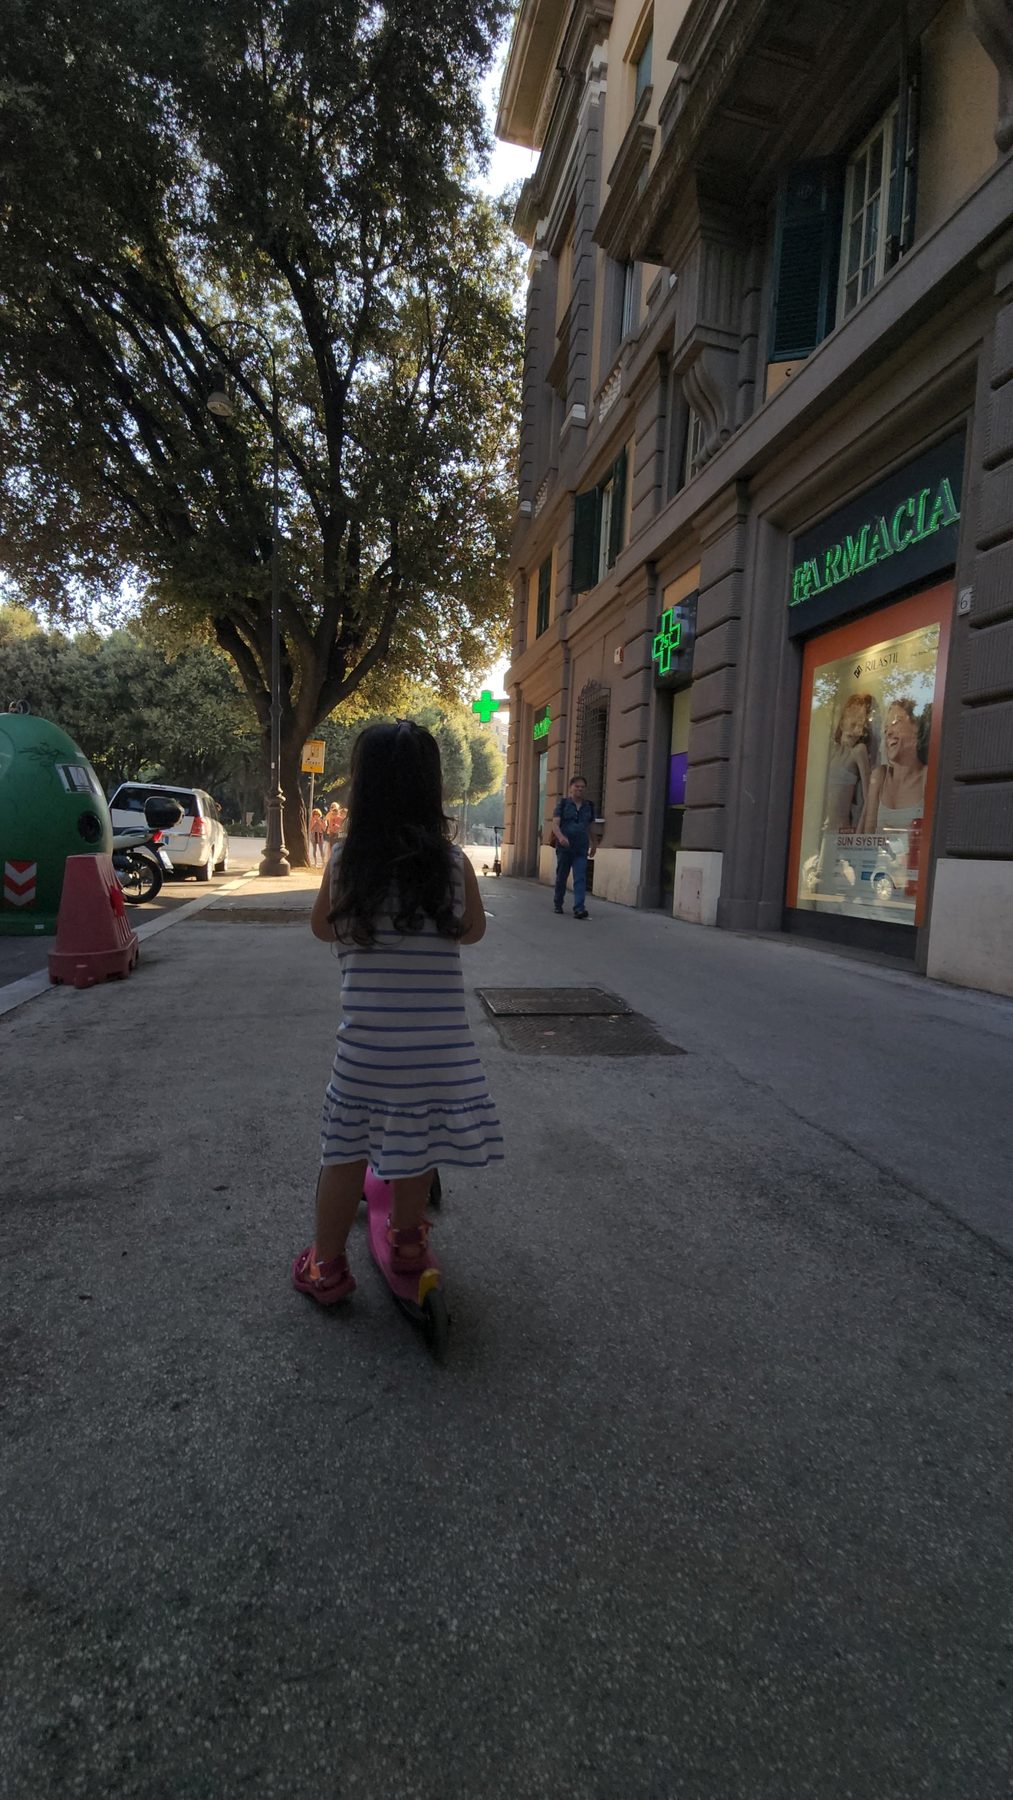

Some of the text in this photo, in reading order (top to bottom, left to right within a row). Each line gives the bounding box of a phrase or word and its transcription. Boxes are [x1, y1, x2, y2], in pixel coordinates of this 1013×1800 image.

[788, 477, 961, 607] FARMACIA
[837, 836, 891, 847] SUN SYSTEM
